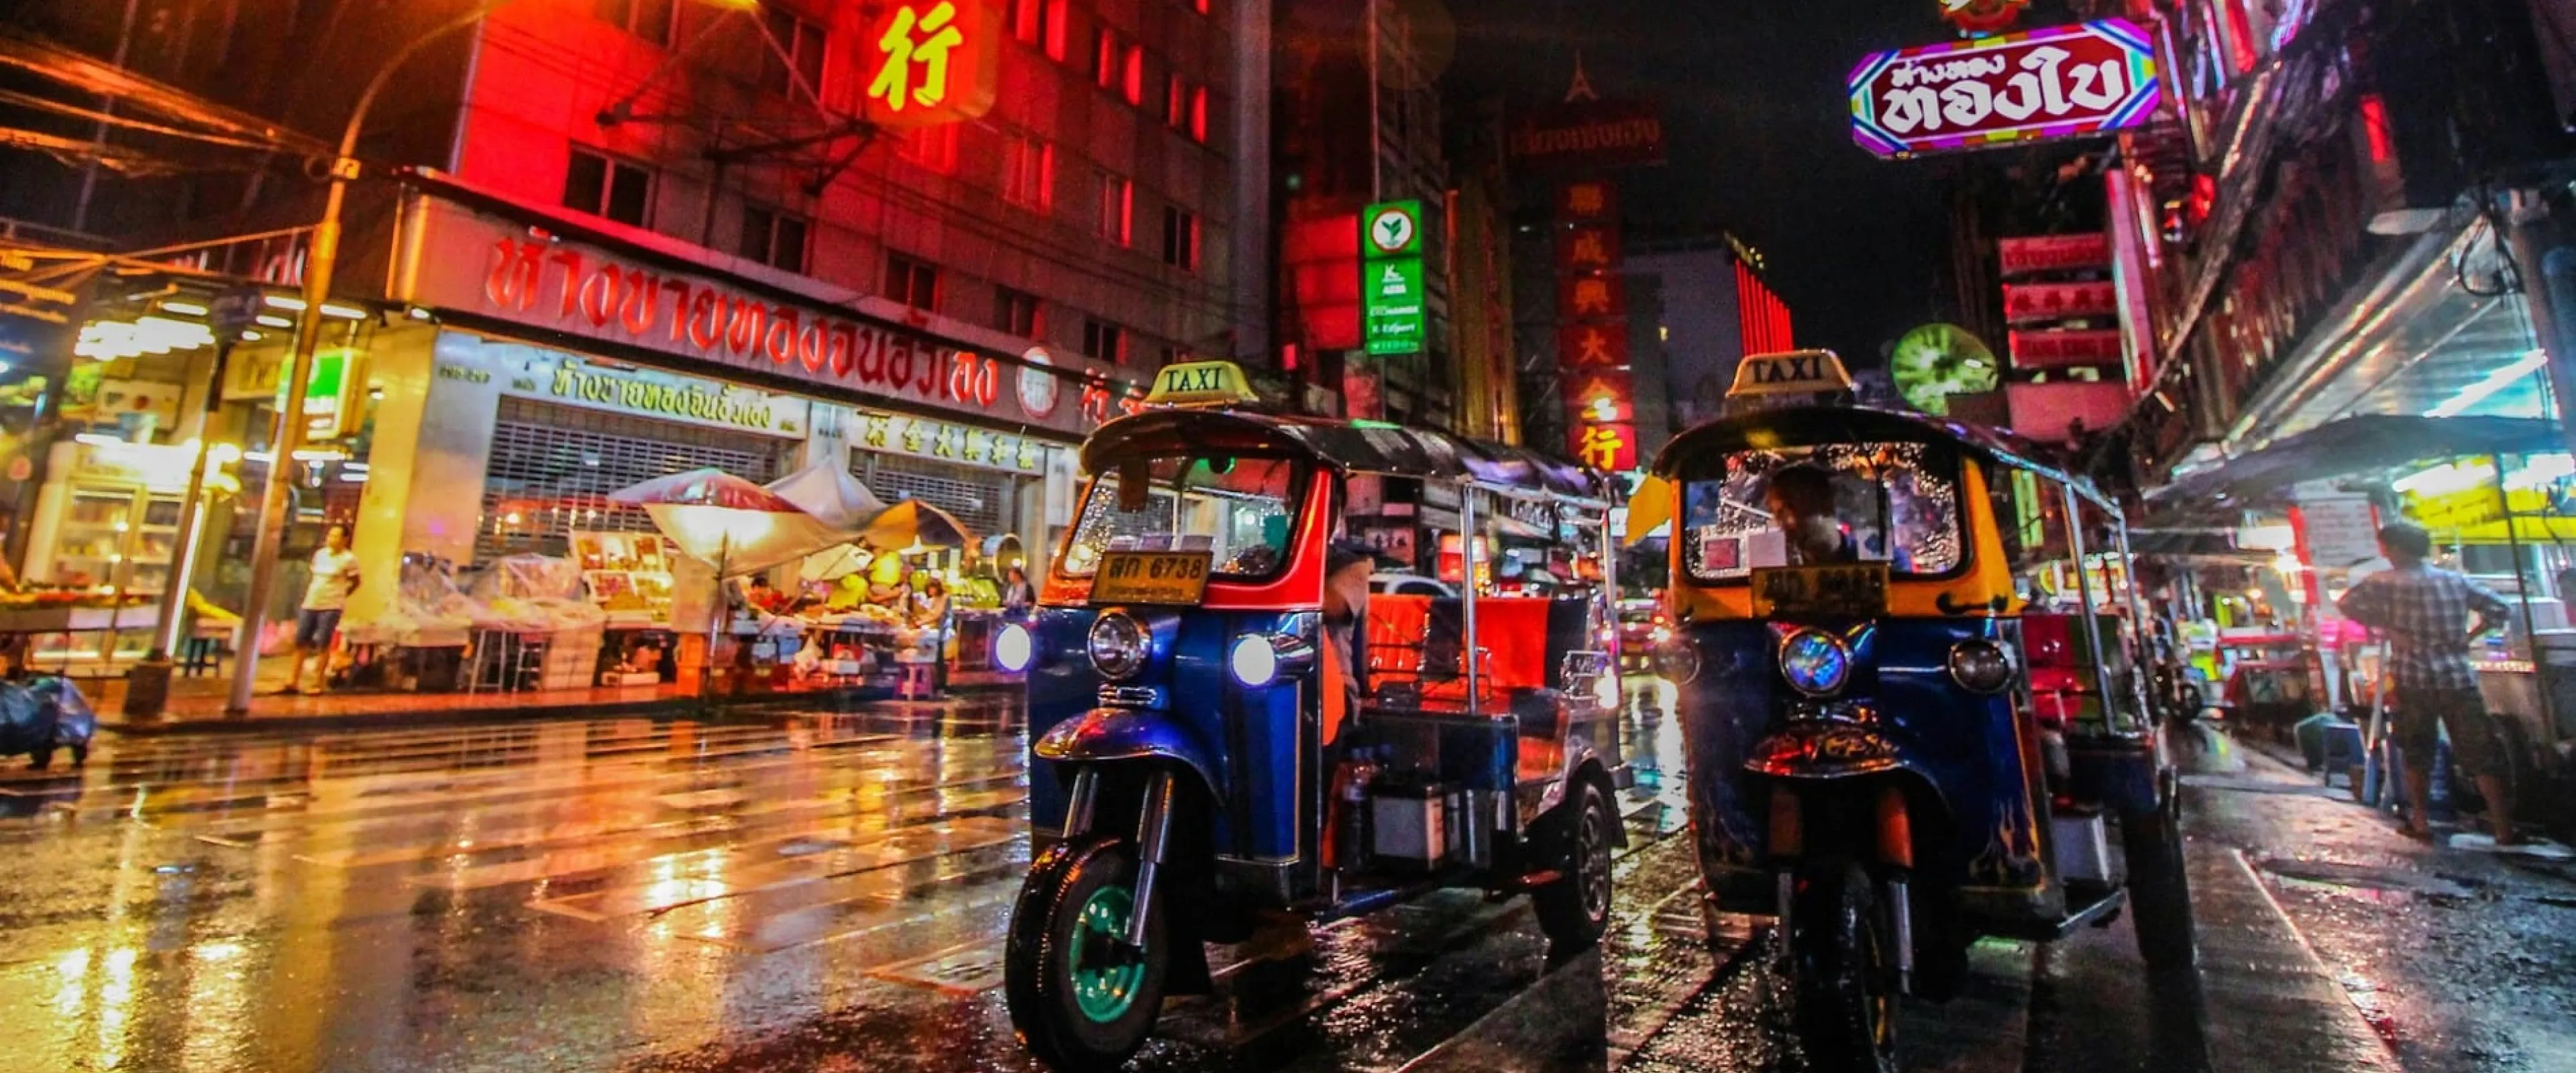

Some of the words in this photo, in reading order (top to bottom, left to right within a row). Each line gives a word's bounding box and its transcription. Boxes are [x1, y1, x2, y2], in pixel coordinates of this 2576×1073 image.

[867, 1, 963, 111] 行
[1881, 46, 2125, 133] ทองใบ
[1165, 367, 1222, 391] TAXI
[1746, 355, 1821, 383] TAXI
[1150, 557, 1203, 579] 6738
